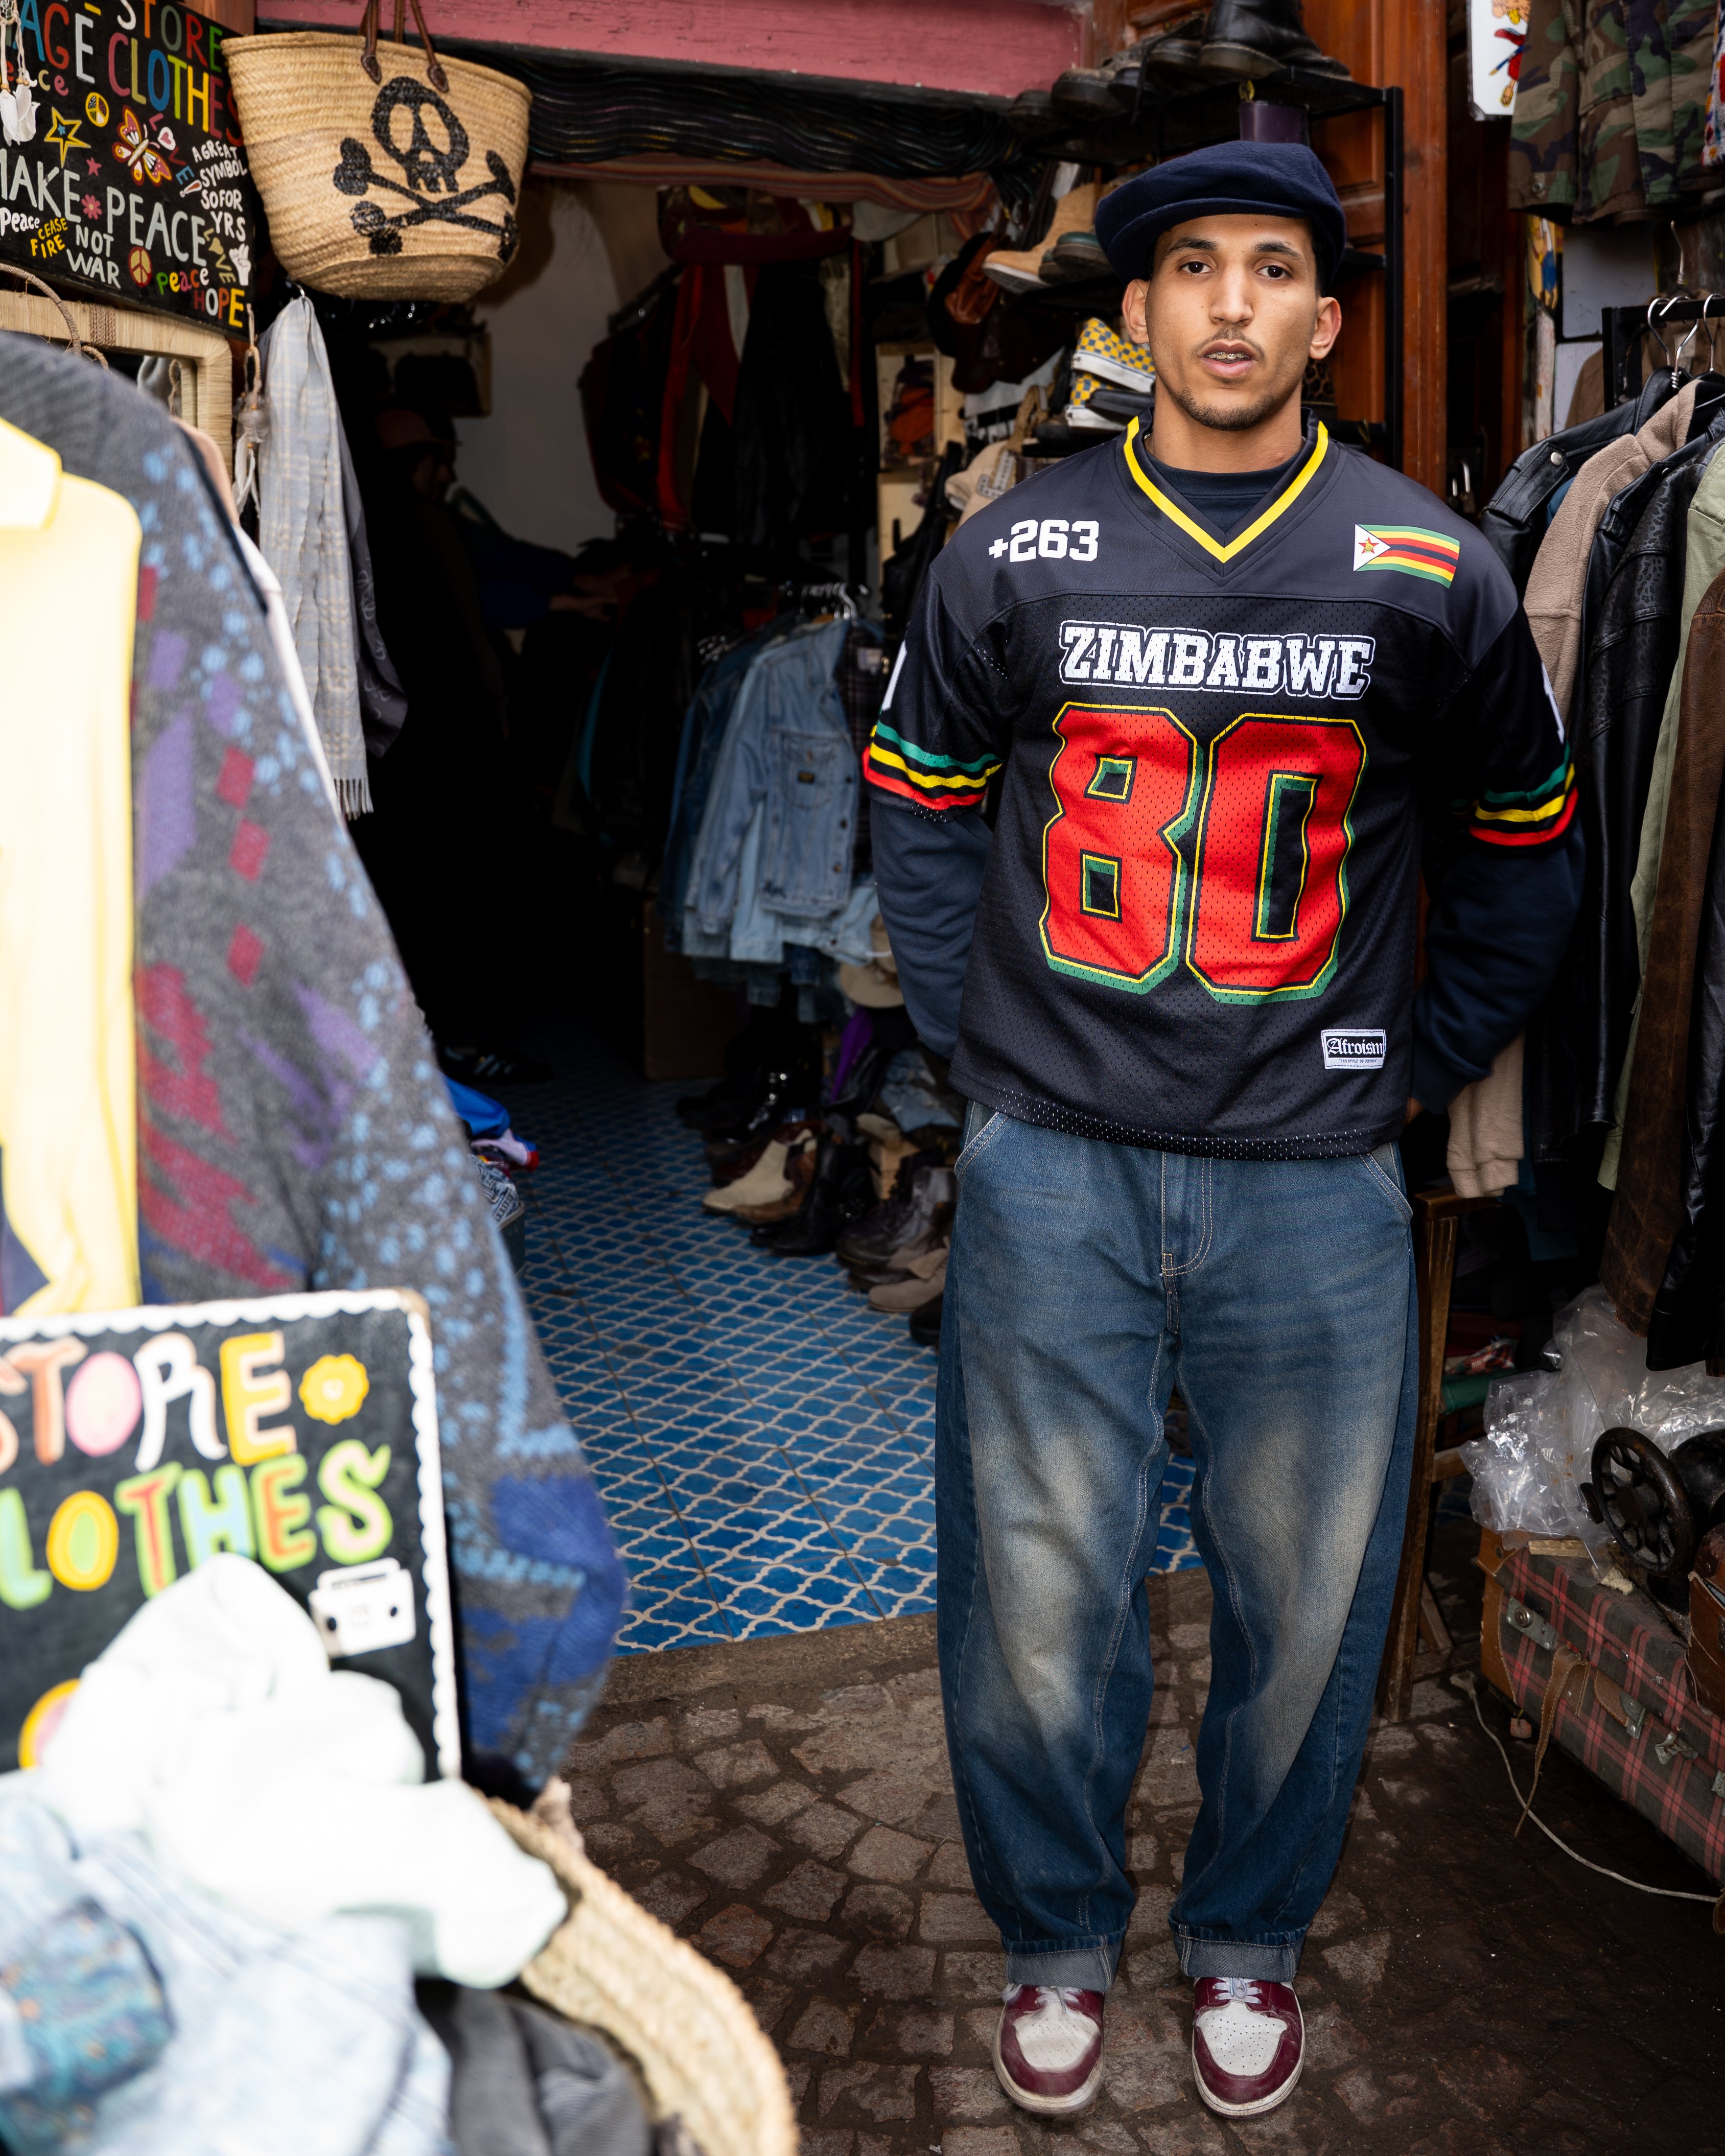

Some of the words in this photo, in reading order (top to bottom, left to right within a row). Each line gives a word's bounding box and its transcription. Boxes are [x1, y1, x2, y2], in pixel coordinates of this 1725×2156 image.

[117, 0, 223, 73] STORE
[6, 0, 96, 84] AGE
[108, 32, 243, 147] CLOTHES
[200, 159, 248, 188] SYMBOL
[38, 218, 68, 240] CEASE
[76, 224, 114, 257] NOT
[107, 186, 206, 267] PEACE
[210, 210, 246, 242] YRS
[31, 234, 65, 259] FIRE
[66, 249, 121, 289] WAR
[194, 288, 245, 327] HOPE
[988, 519, 1099, 563] +263
[1060, 621, 1374, 699] ZIMBABWE
[1039, 702, 1368, 1005] 80
[1326, 1037, 1383, 1055] Afroism
